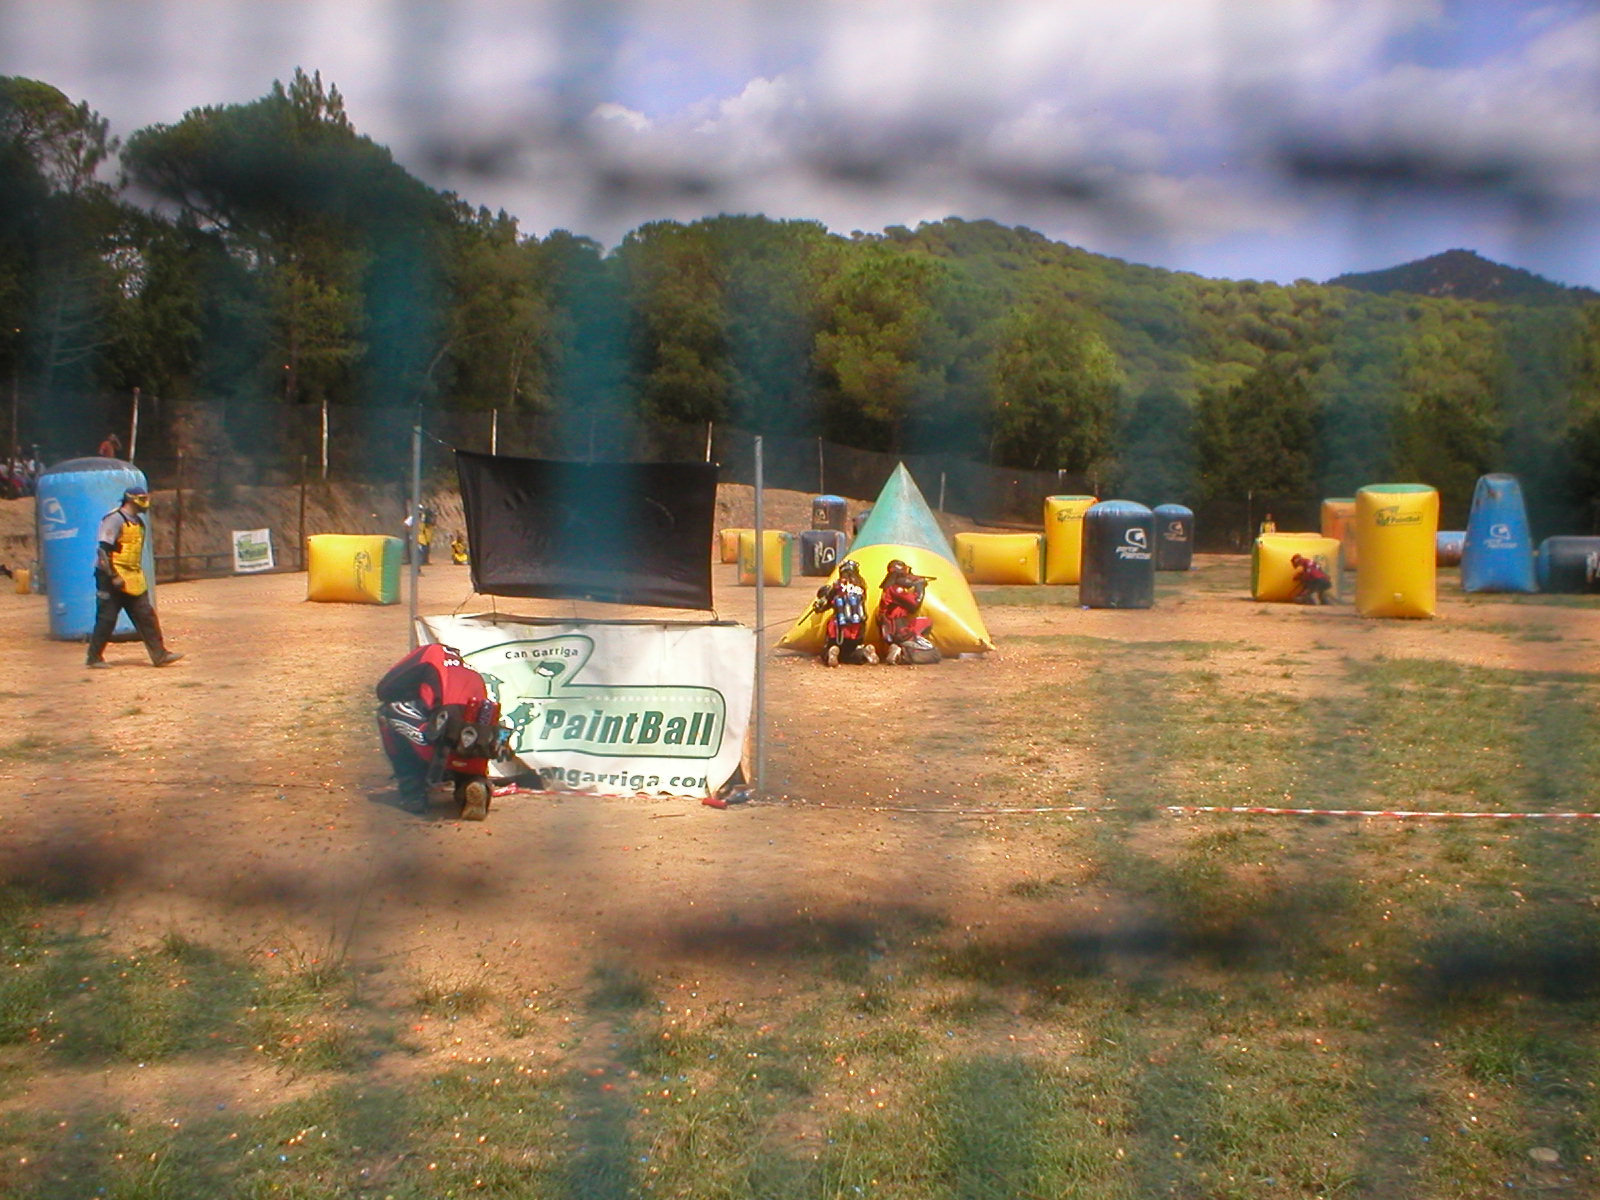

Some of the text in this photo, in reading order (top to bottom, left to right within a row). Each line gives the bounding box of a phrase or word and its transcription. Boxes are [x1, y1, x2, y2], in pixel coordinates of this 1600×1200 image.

[505, 646, 579, 659] Can Garriga
[539, 708, 716, 746] PaintBall
